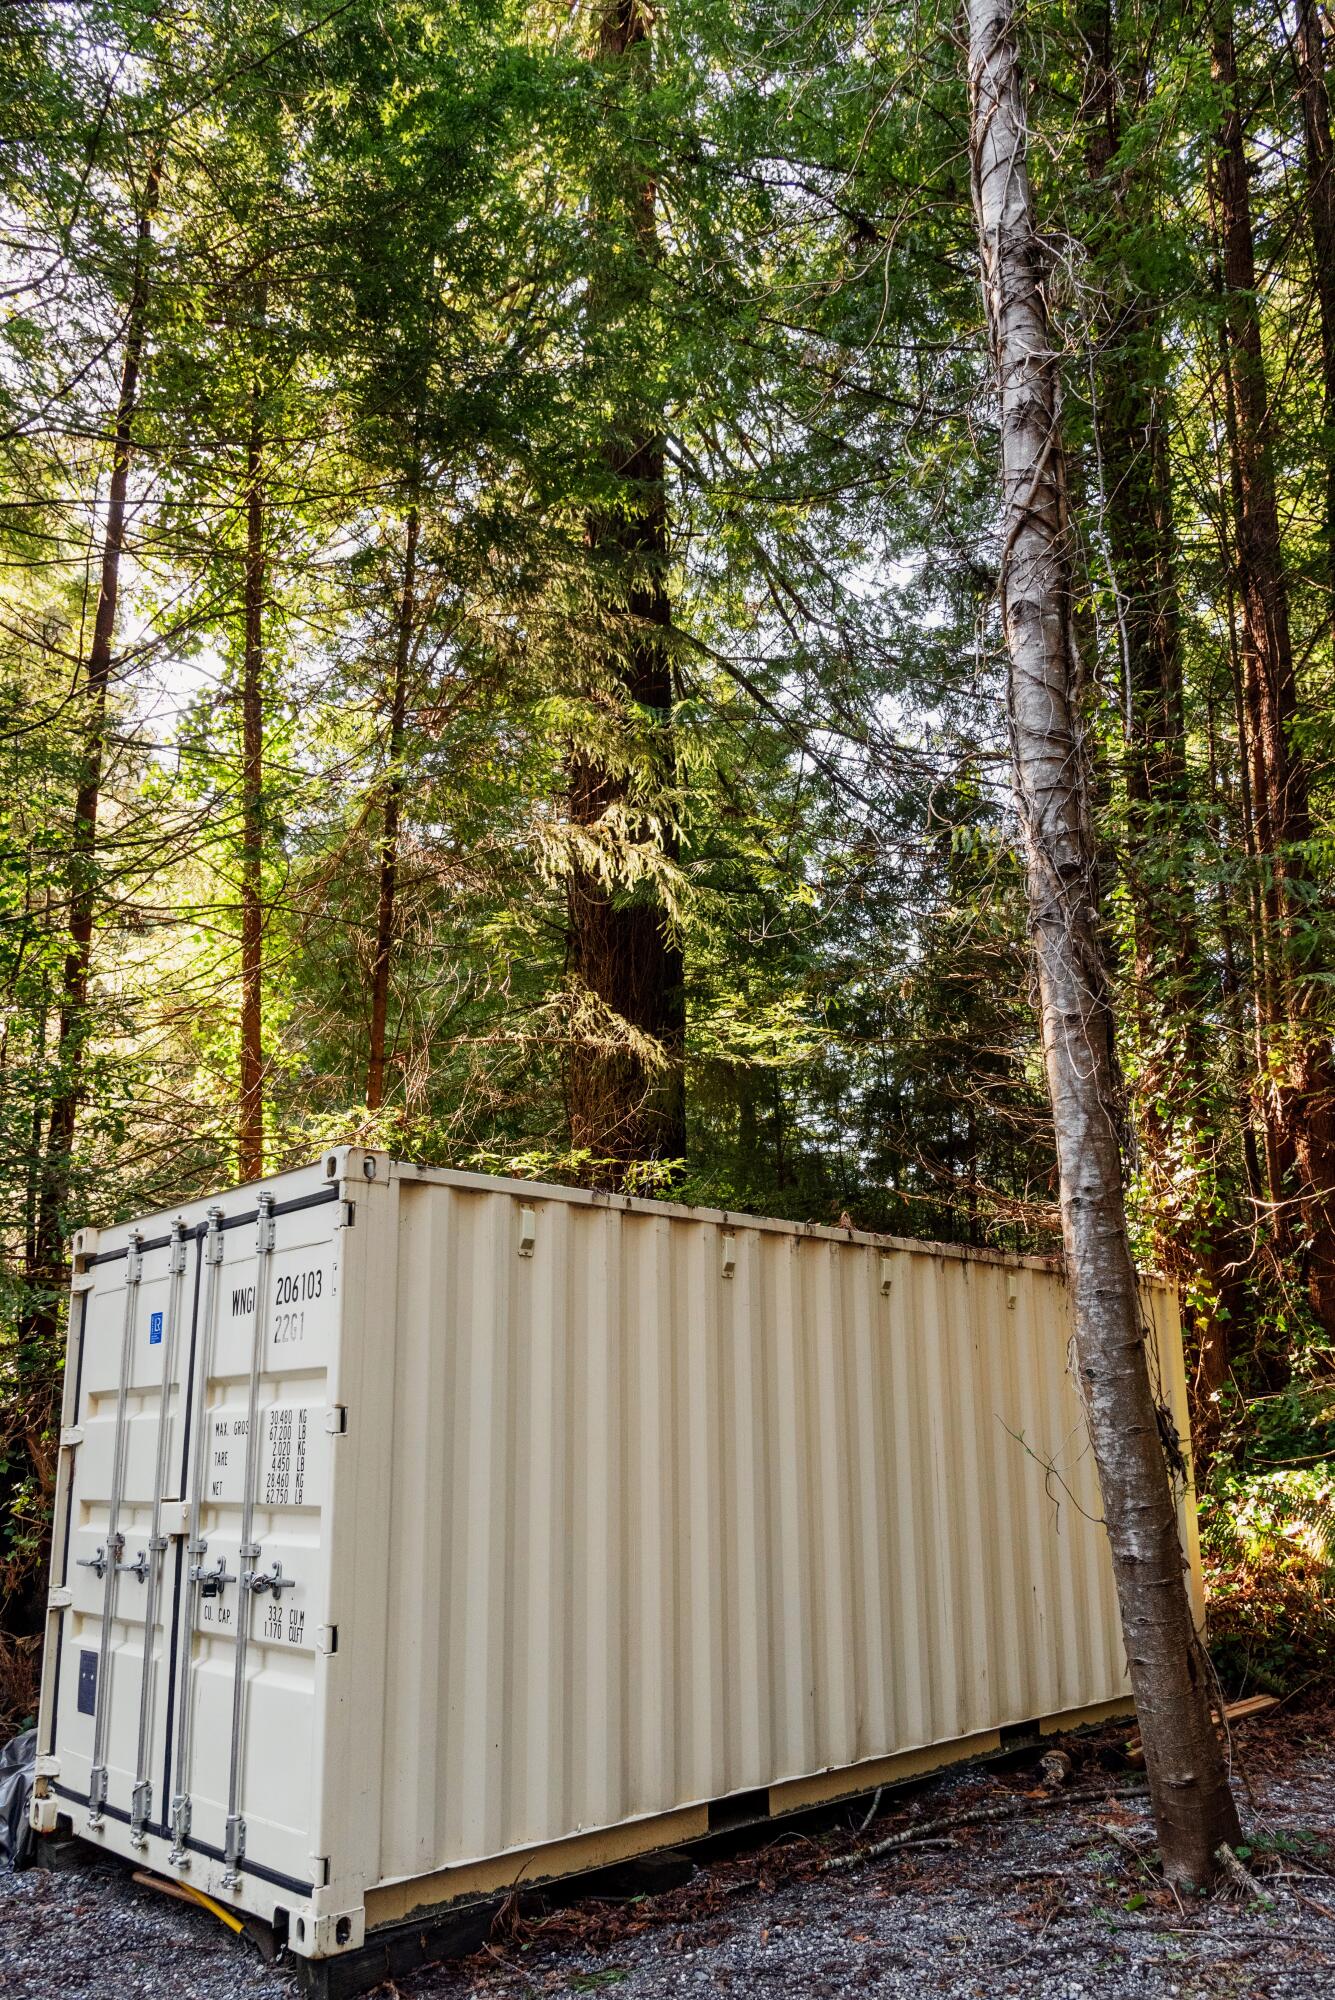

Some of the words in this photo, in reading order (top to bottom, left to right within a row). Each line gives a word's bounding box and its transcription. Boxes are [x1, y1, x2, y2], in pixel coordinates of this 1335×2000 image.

[275, 1269, 323, 1306] 206103
[299, 1409, 307, 1424] KG
[215, 1422, 229, 1437] MAX.
[269, 1425, 292, 1441] 67.200
[298, 1424, 306, 1440] LB
[272, 1441, 291, 1457] 2.020
[297, 1441, 306, 1456] KG
[214, 1451, 228, 1467] TARE
[271, 1456, 290, 1472] 4.450
[296, 1456, 305, 1472] LB
[266, 1472, 289, 1488] 28.460
[295, 1473, 304, 1488] KG
[212, 1481, 223, 1496] NET
[266, 1489, 289, 1504] 62.750
[294, 1488, 303, 1505] LB
